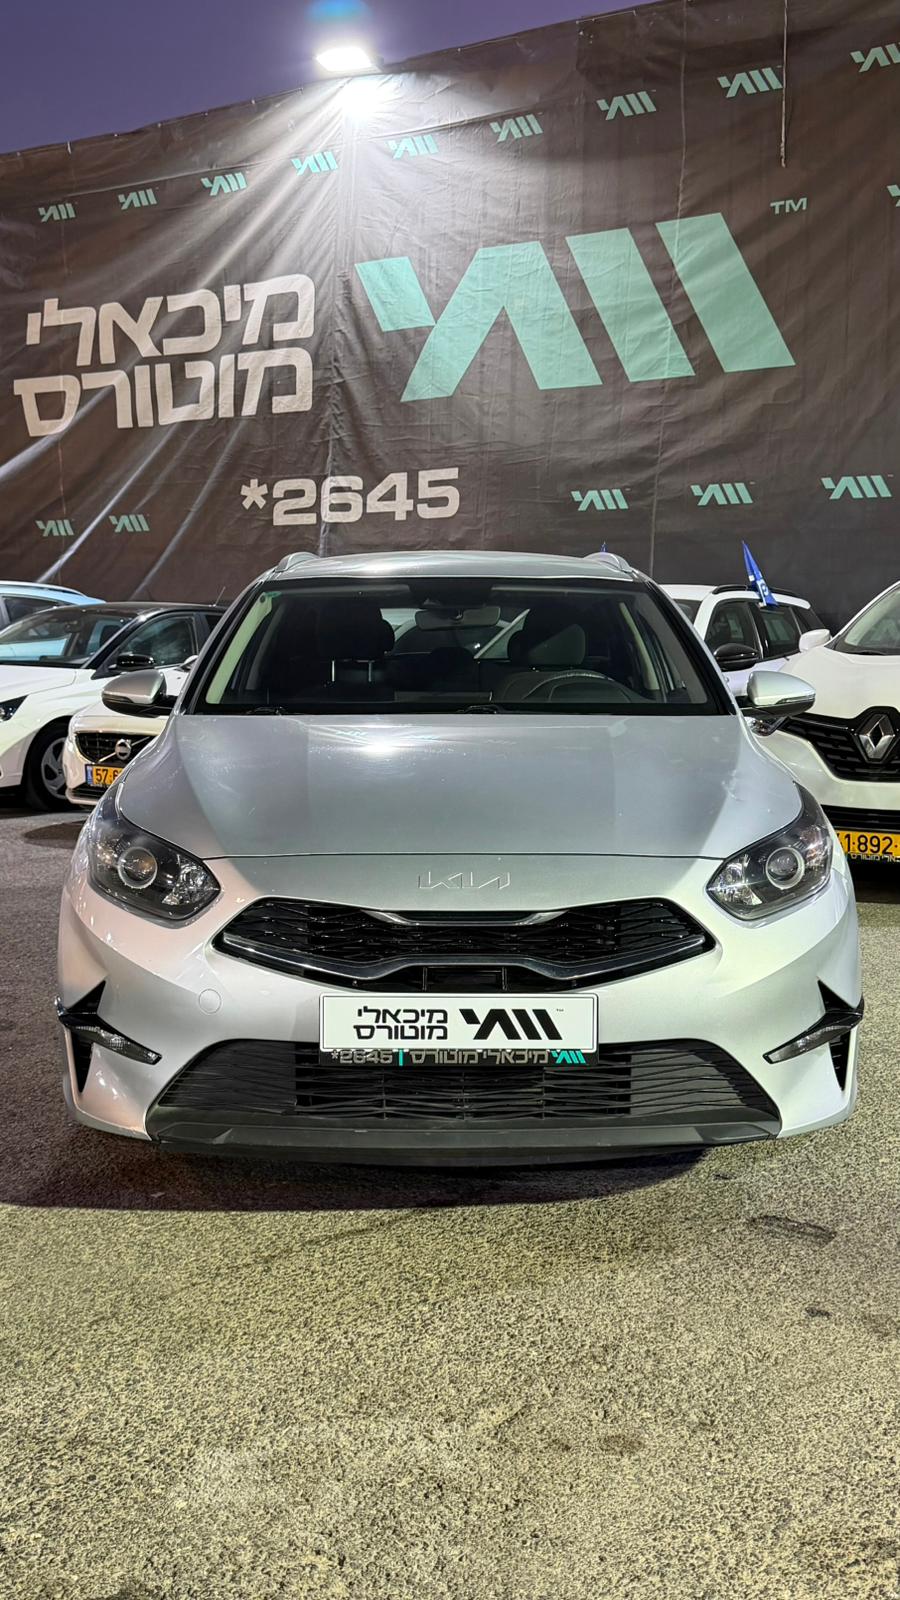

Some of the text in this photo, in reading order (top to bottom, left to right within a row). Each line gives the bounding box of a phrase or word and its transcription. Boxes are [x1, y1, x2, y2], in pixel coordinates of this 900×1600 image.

[769, 197, 808, 215] TM
[26, 274, 315, 367] מיכאלי
[13, 347, 313, 437] מוטורס
[357, 1005, 448, 1024] מיכאלי
[353, 1025, 448, 1040] מוטורס
[408, 1049, 479, 1064] מוטורס
[482, 1049, 549, 1065] מיכאלי
